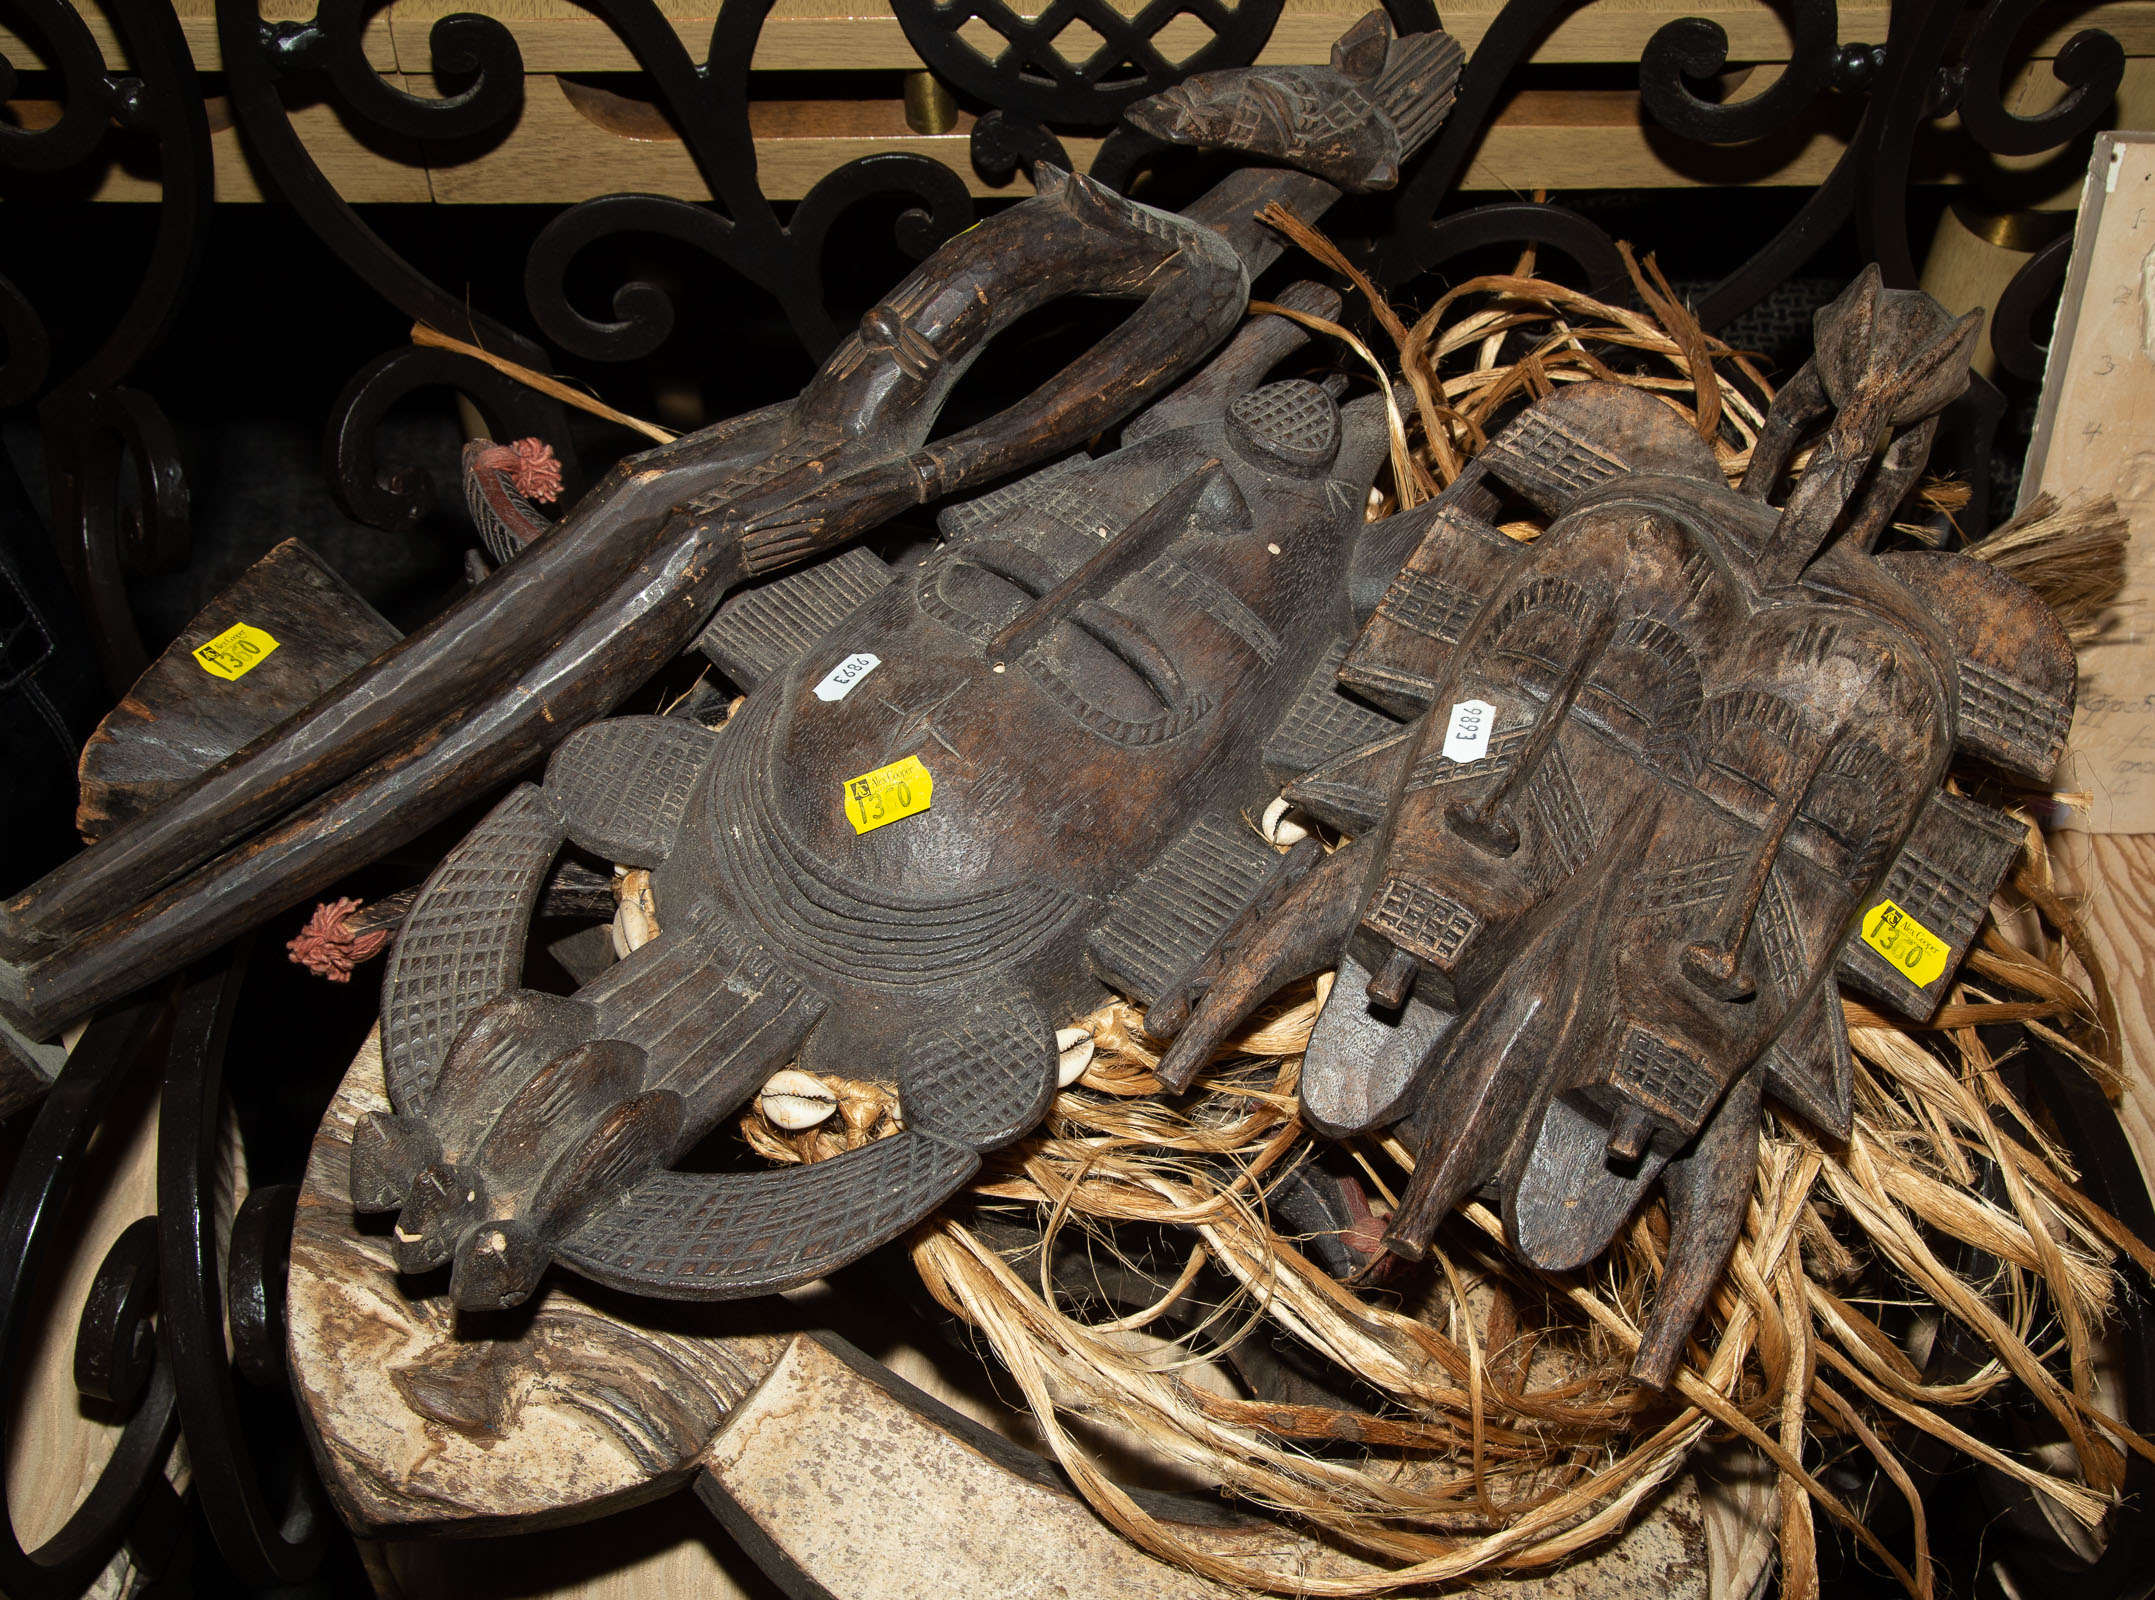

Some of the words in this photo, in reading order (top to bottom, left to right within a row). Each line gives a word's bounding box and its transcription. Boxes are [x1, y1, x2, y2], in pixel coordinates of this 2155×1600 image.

[2093, 354, 2116, 376] 3
[832, 657, 870, 684] 9893
[1455, 707, 1483, 740] 9893
[1900, 921, 1915, 937] Alex
[1915, 931, 1940, 954] Cooper
